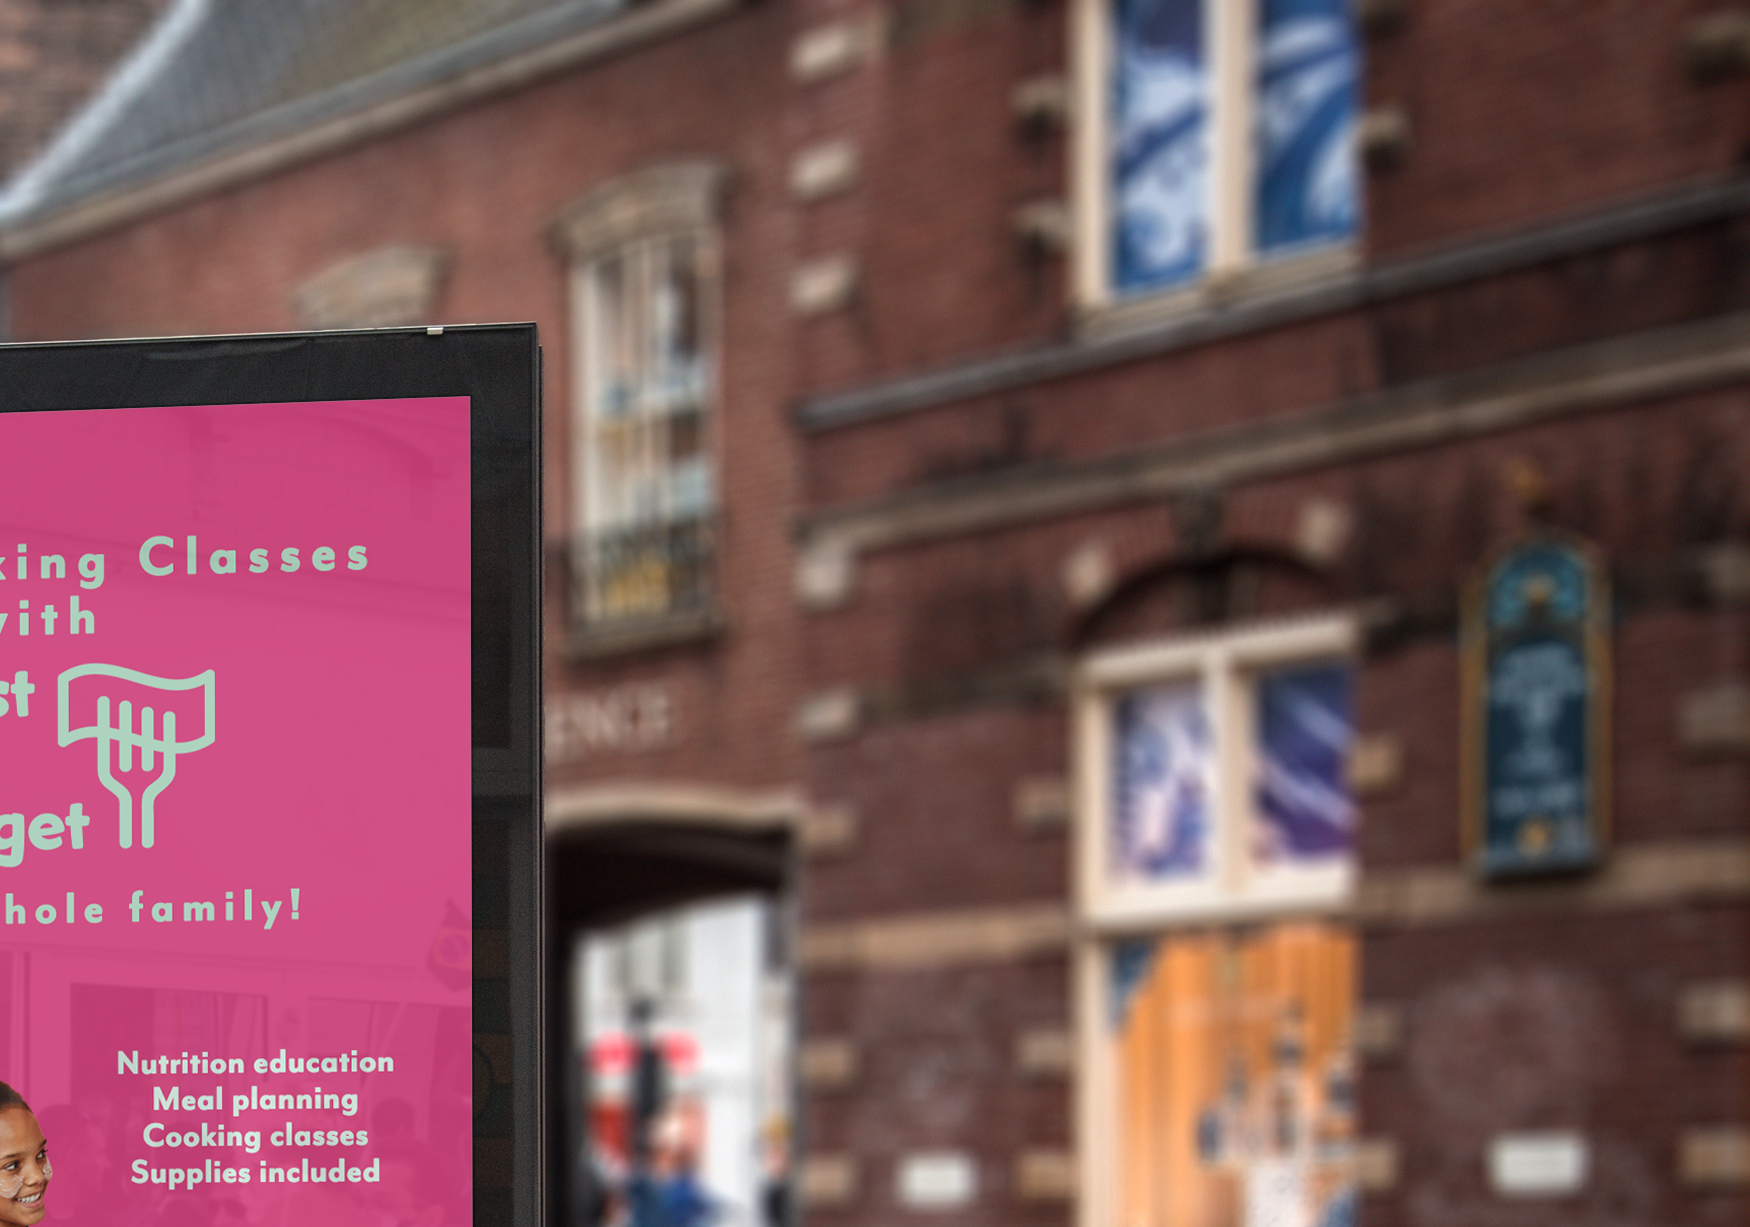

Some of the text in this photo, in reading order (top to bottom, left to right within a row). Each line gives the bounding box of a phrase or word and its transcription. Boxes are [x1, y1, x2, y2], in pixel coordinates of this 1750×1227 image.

[138, 535, 370, 578] Classes
[129, 887, 302, 930] family!
[117, 1048, 394, 1076] Nutrition education
[153, 1085, 359, 1118] Meal planning
[142, 1121, 369, 1154] Cooking classes
[131, 1157, 380, 1191] Supplies included
